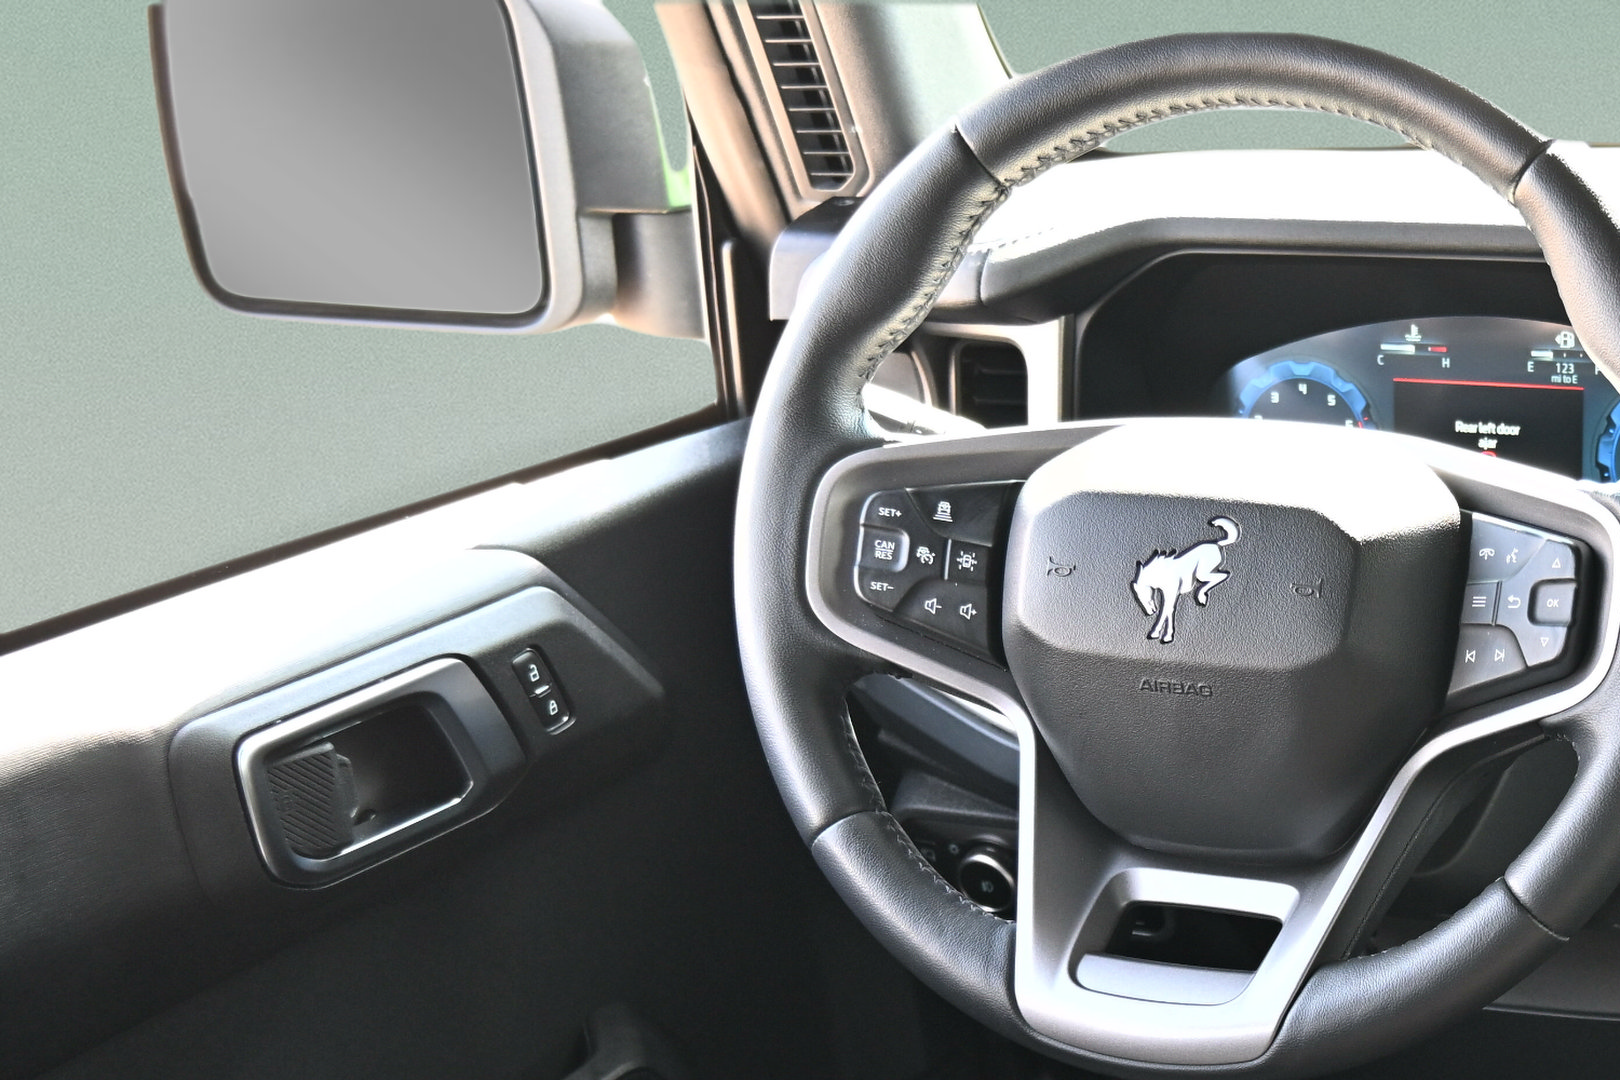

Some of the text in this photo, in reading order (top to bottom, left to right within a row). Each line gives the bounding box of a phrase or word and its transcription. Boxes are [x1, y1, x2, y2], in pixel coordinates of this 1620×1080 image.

[1376, 354, 1385, 366] C
[1441, 357, 1451, 369] H
[1527, 361, 1535, 373] E
[1555, 362, 1575, 374] 123
[1551, 374, 1561, 384] mi
[1562, 374, 1572, 384] to
[1298, 383, 1308, 395] 4
[1270, 391, 1280, 404] 3
[1327, 394, 1337, 407] 5
[1455, 420, 1521, 436] Rear left door
[1477, 437, 1498, 450] ajar
[878, 507, 902, 516] SET+
[875, 540, 895, 550] CAN
[875, 552, 893, 561] RES
[1546, 598, 1560, 608] OK
[1138, 678, 1213, 697] AIRBAG
